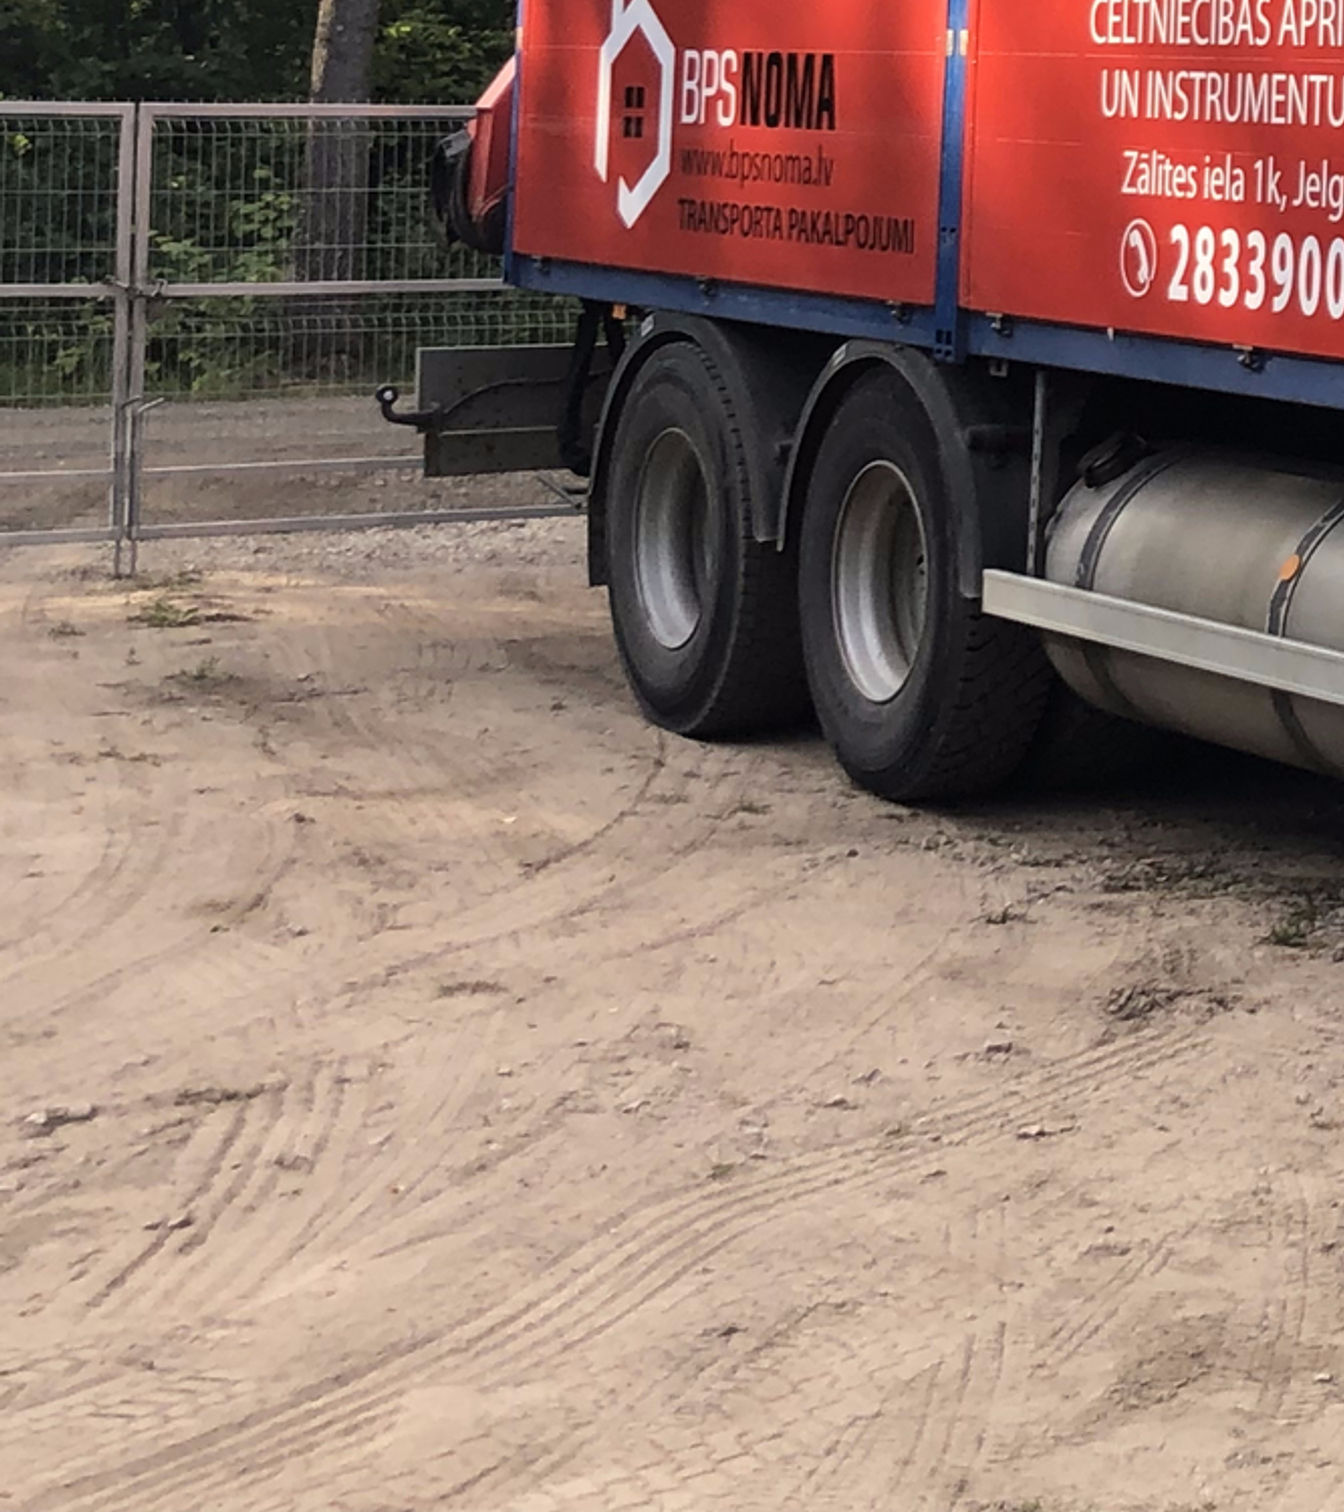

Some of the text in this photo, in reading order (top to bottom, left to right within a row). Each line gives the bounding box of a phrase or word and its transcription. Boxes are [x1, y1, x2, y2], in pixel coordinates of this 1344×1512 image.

[1101, 69, 1138, 118] UN
[678, 139, 835, 189] www.bpsnoma.lv
[1121, 149, 1198, 199] Zālītes
[1203, 153, 1246, 202] iela
[678, 197, 916, 255] TRANSPORTA PAKALPOJUMI
